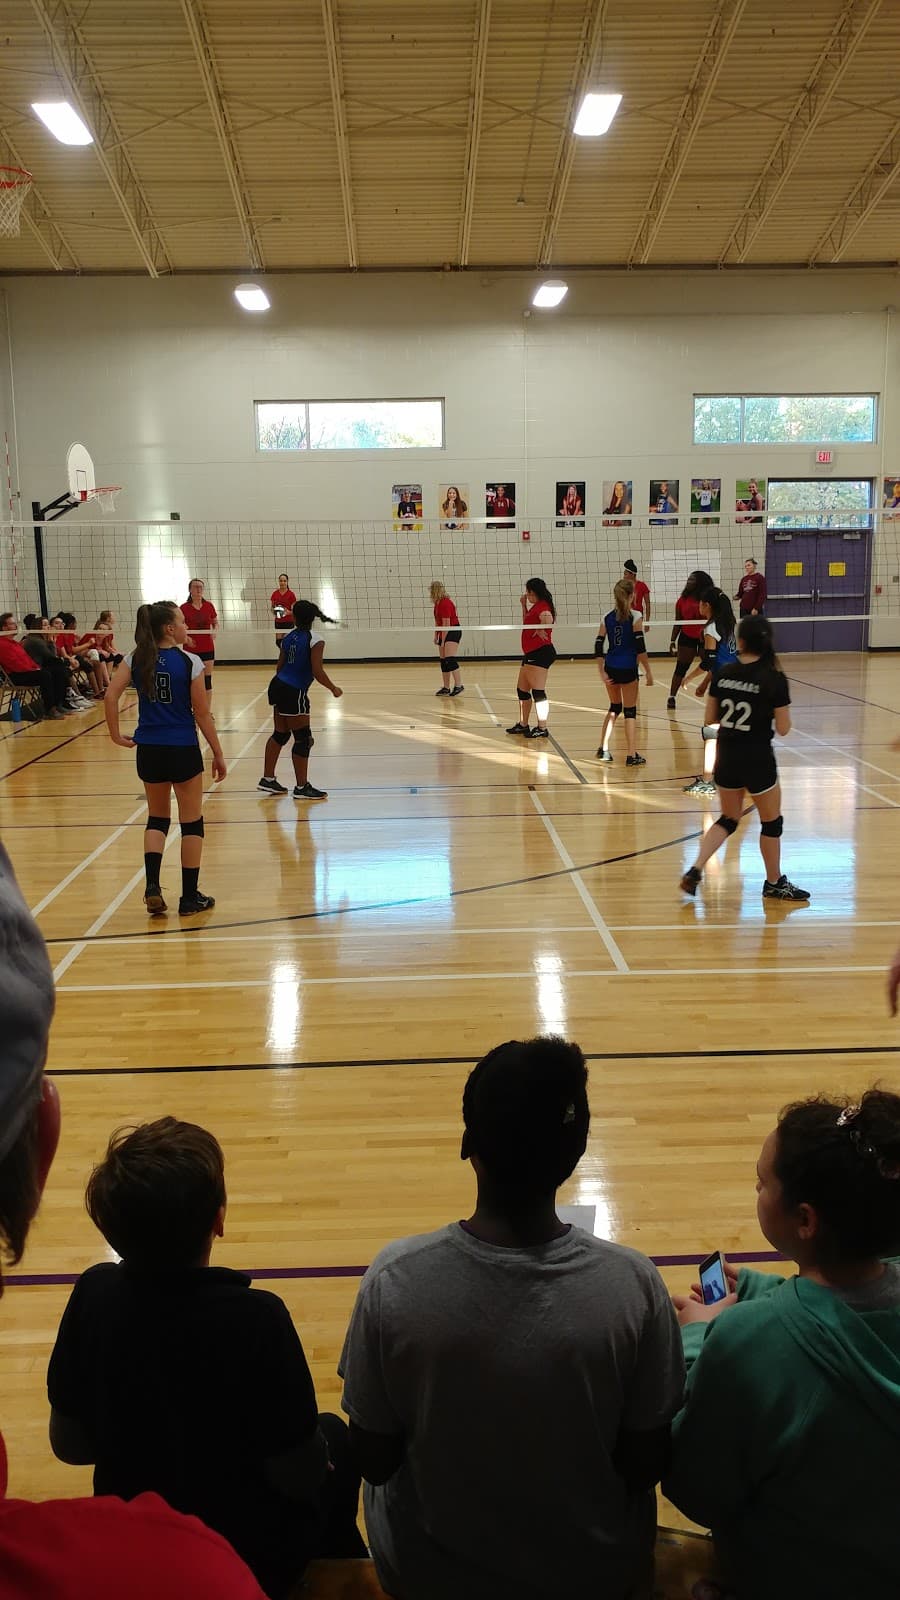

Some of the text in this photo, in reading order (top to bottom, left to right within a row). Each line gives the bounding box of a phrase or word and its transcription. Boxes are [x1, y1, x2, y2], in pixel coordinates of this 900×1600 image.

[818, 451, 831, 462] EXIT
[614, 625, 623, 646] 2
[717, 678, 760, 694] COUGARS
[720, 698, 752, 732] 22
